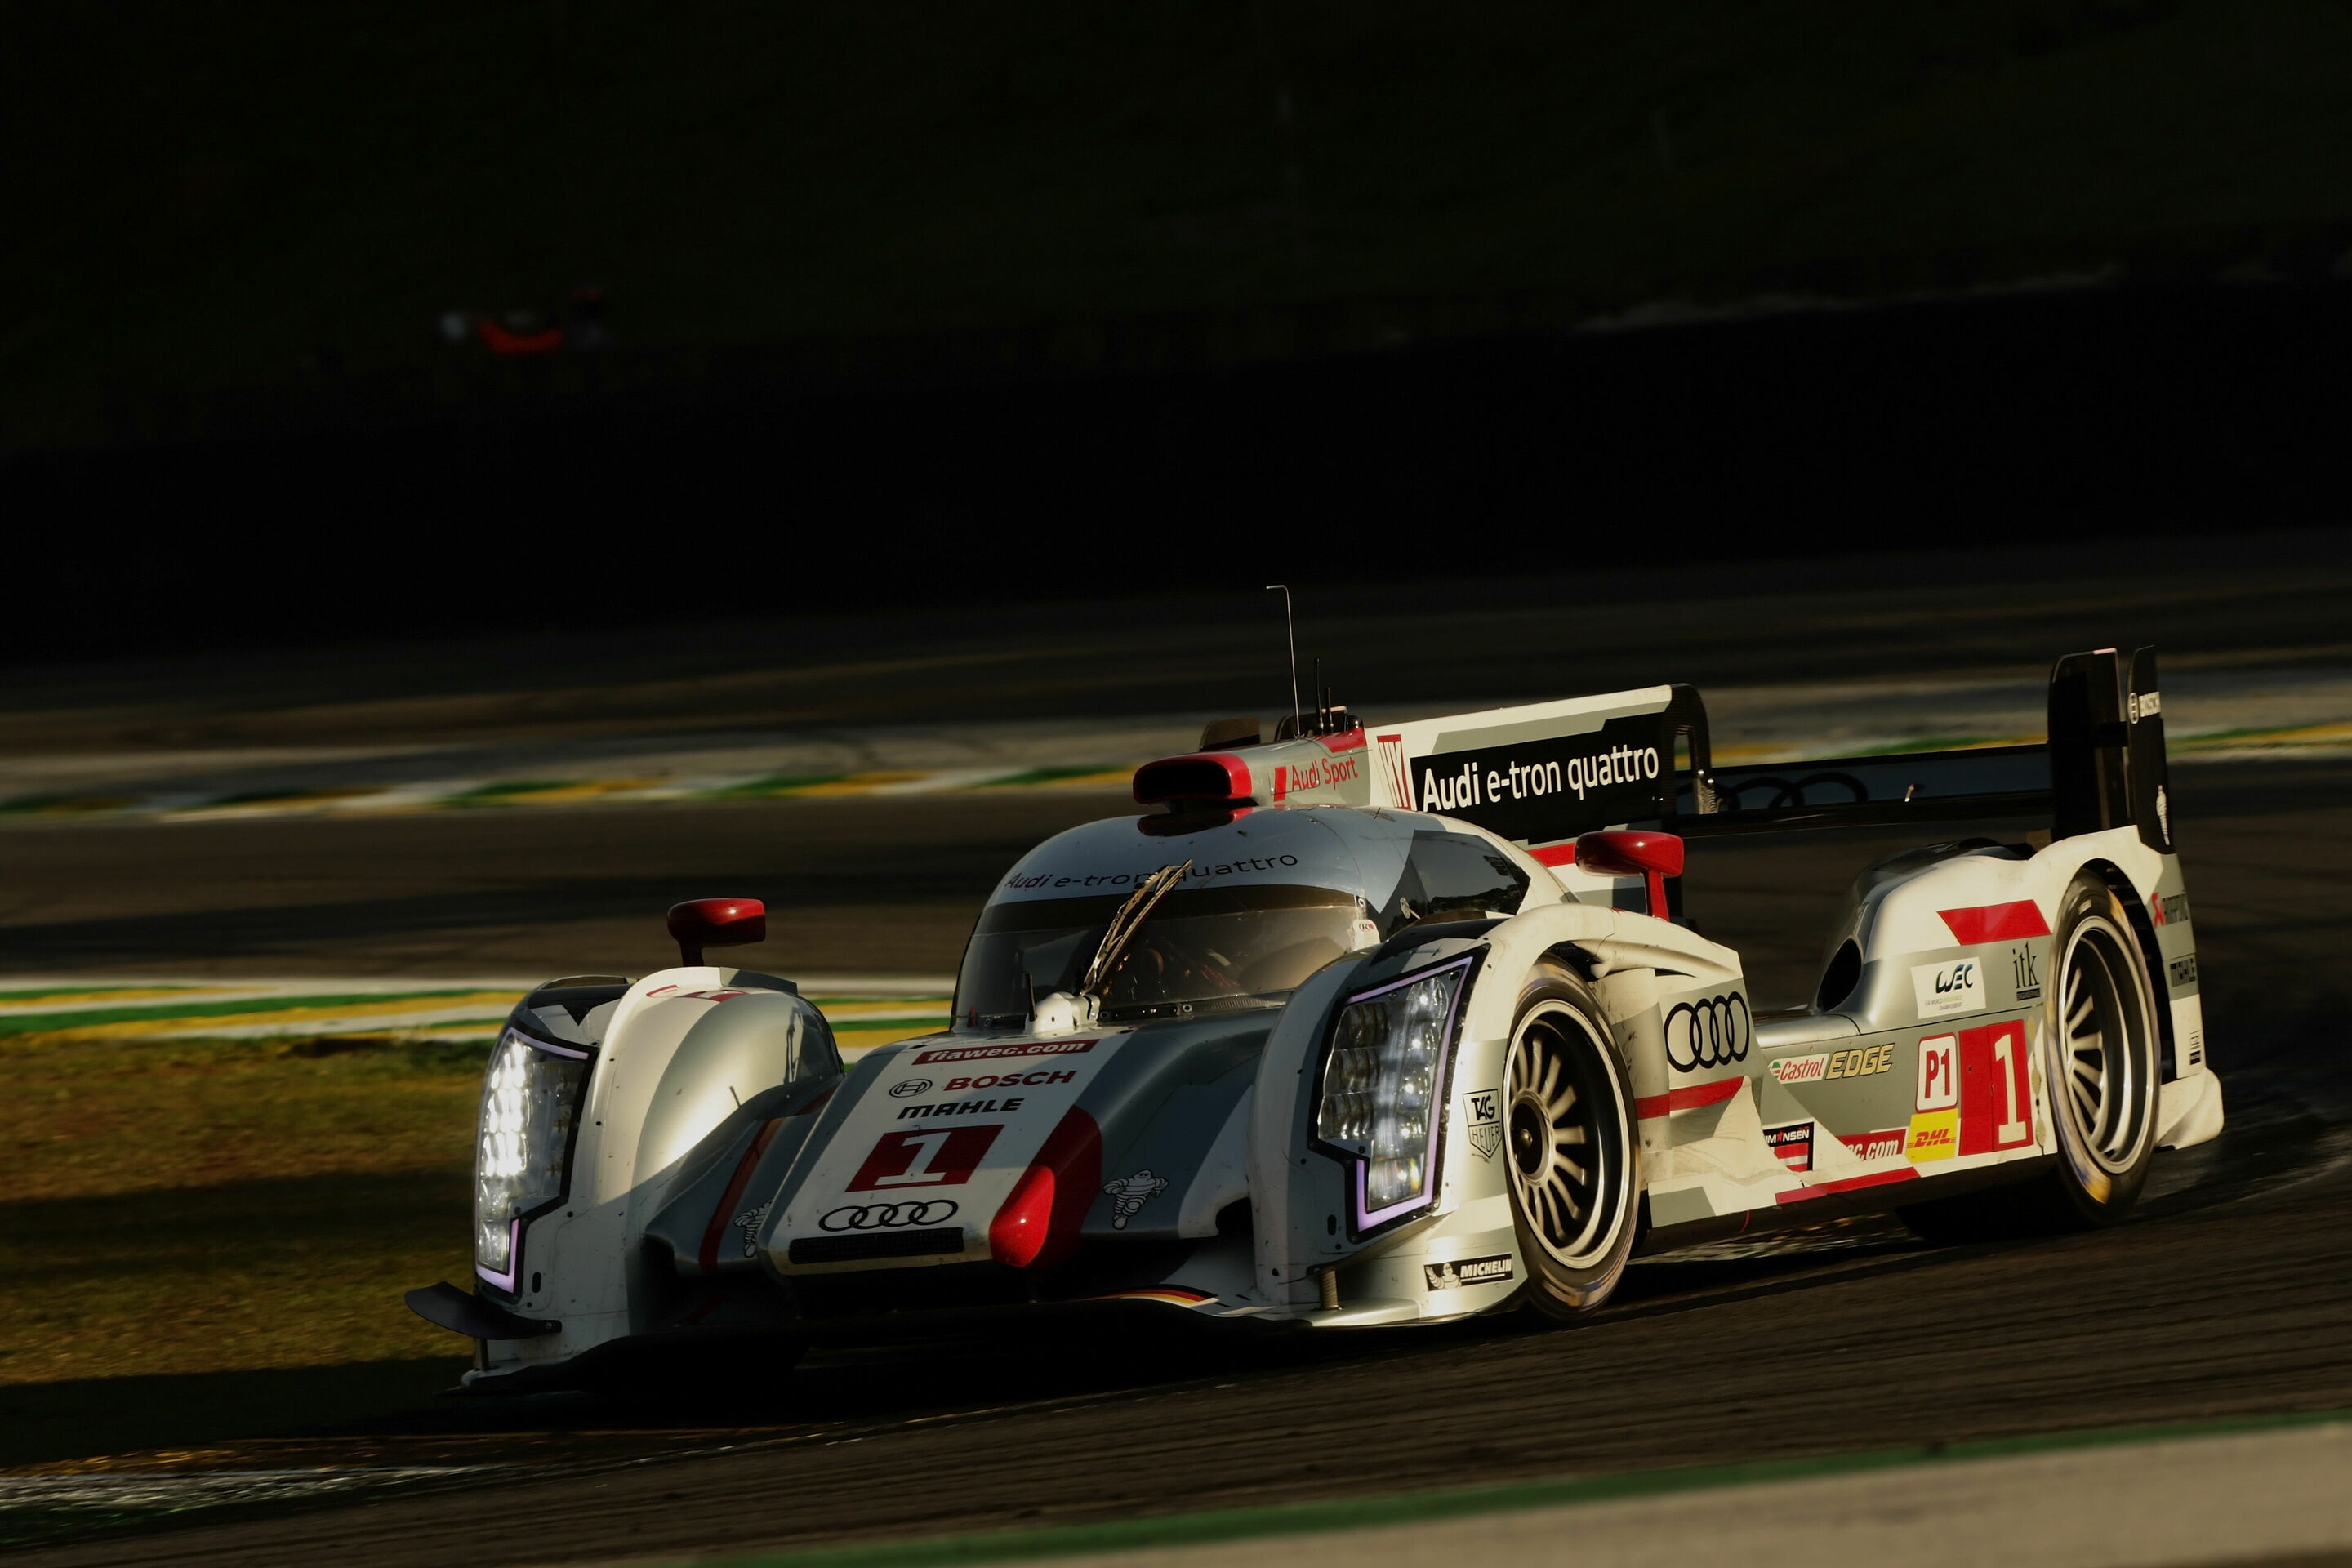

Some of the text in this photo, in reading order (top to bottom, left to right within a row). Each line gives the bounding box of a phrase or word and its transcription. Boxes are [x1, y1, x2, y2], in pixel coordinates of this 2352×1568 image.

[1291, 756, 1358, 791] Audi Sport
[1423, 744, 1659, 813] Audi e-tron quattro
[1005, 872, 1054, 889] Audi
[2012, 941, 2040, 988] itk
[1936, 964, 1973, 994] WEC
[927, 1042, 1085, 1062] fiawec.com
[1780, 1042, 1895, 1081] Castrol EDGE
[943, 1070, 1077, 1091] BOSCH
[1924, 1048, 1950, 1099] P1
[1994, 1033, 2027, 1144] 1
[897, 1098, 1025, 1120] MAHLE
[1471, 1094, 1495, 1121] TAG
[1471, 1125, 1500, 1152] HEUER
[1913, 1129, 1952, 1148] DHL
[873, 1130, 953, 1186] 1
[1459, 1258, 1512, 1279] MICHELIN
